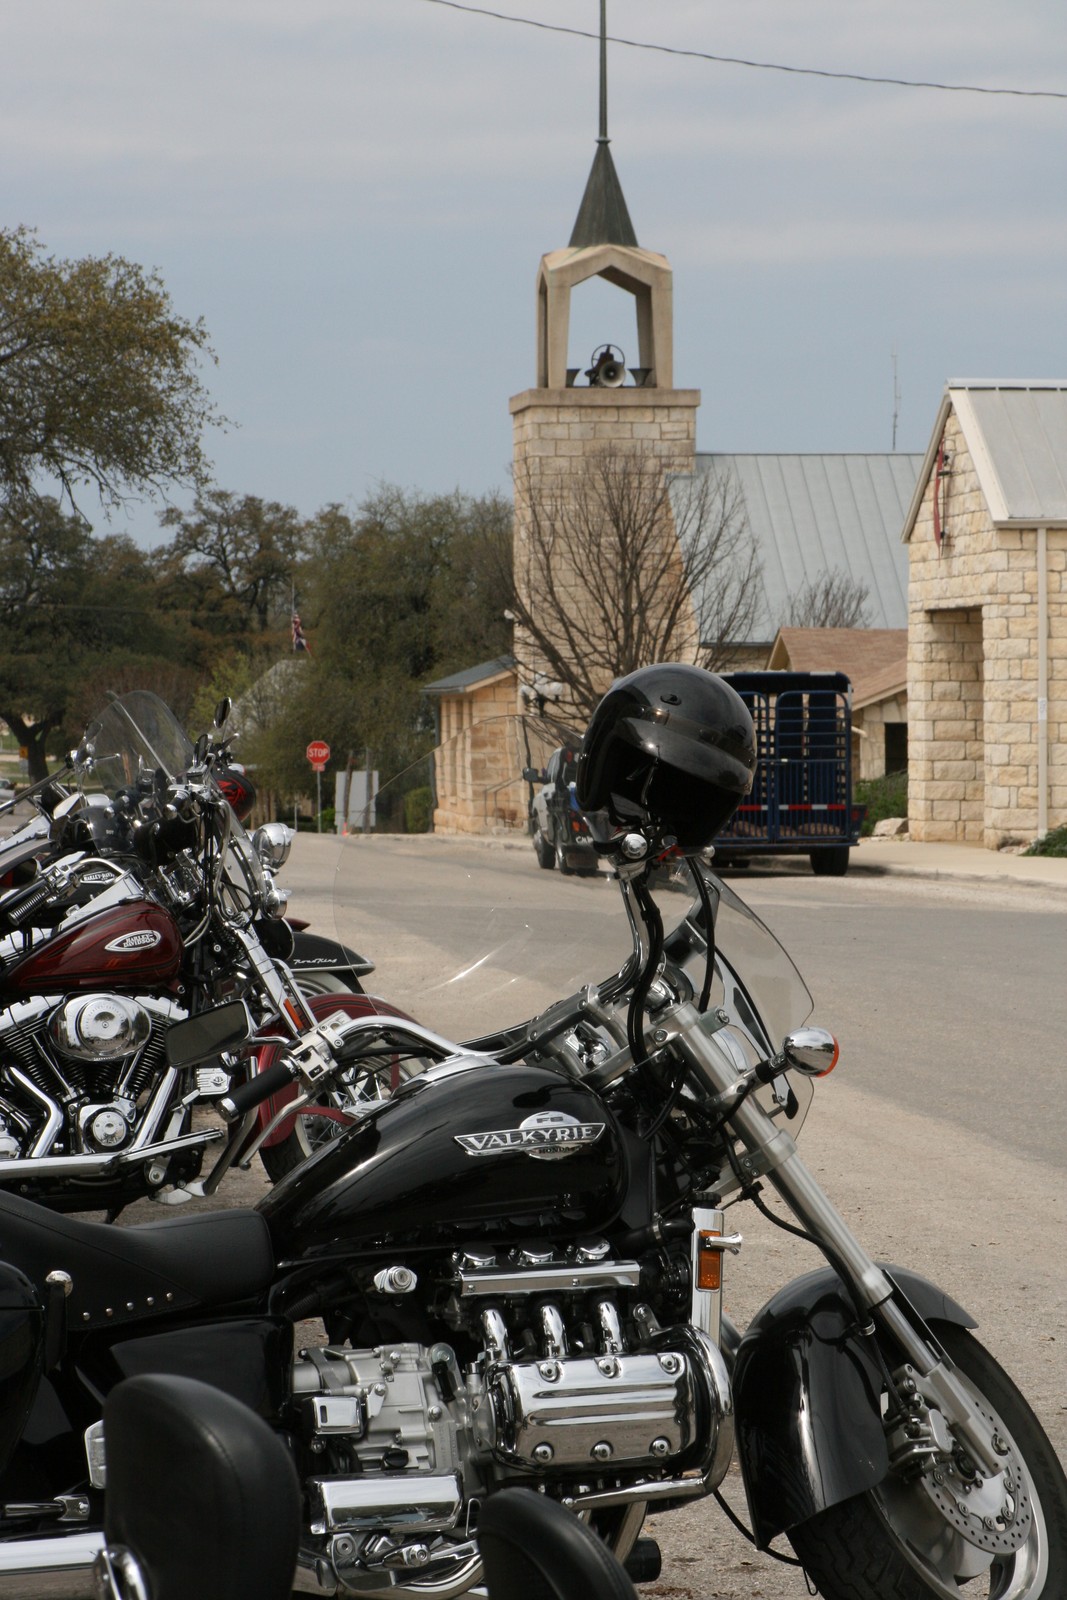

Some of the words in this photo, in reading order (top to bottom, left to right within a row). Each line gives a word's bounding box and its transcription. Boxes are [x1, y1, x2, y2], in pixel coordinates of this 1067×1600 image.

[308, 748, 328, 758] STOP
[123, 937, 155, 948] DAVIDSON
[466, 1126, 596, 1150] VALKYRIE
